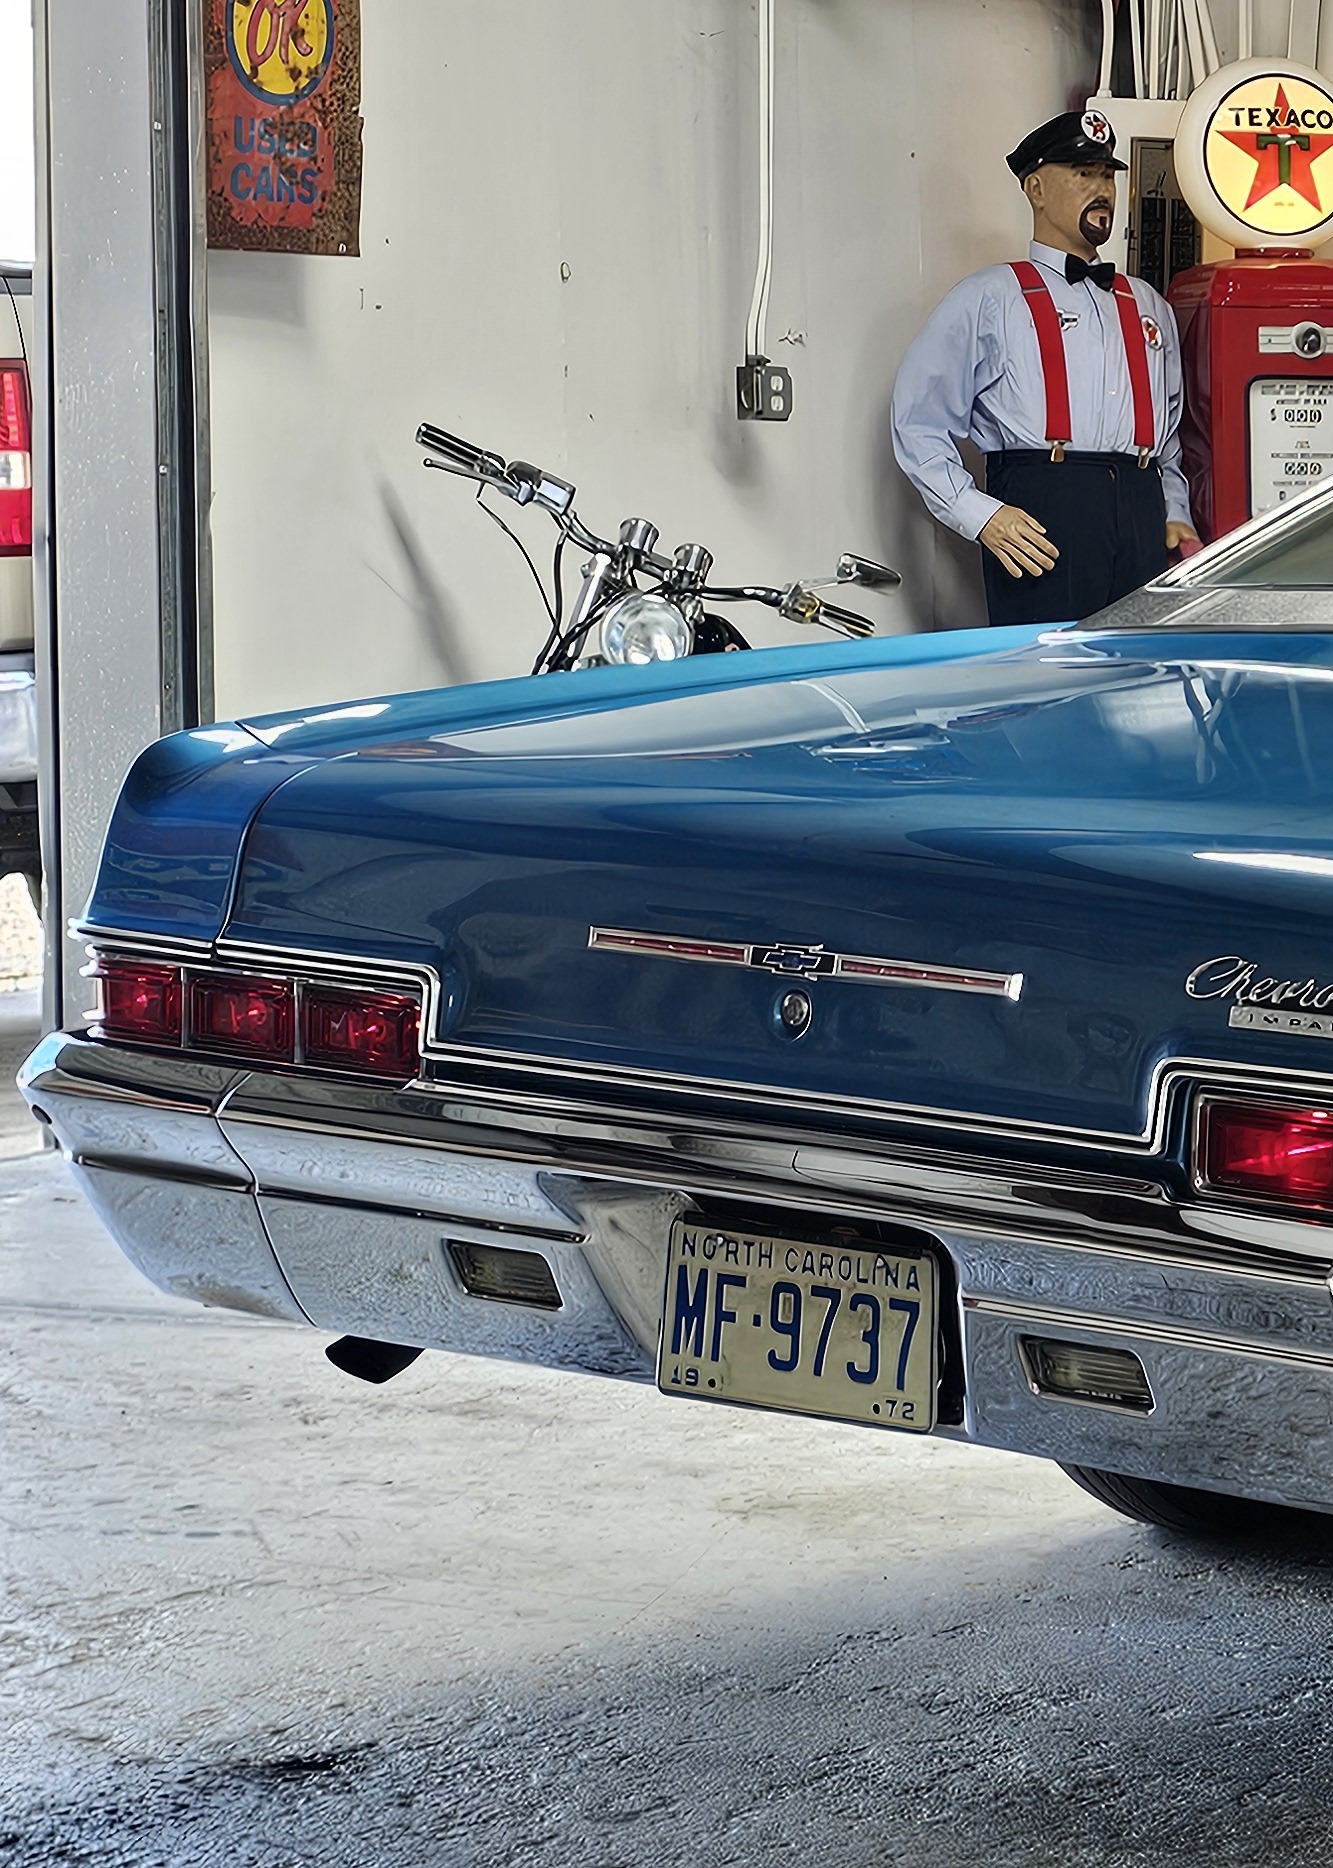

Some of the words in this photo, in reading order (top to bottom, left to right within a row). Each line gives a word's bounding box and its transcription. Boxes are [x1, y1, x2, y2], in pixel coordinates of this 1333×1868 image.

[246, 0, 313, 66] OK
[233, 115, 318, 158] USED
[1228, 107, 1333, 129] TEXACO
[230, 162, 318, 204] CARS
[682, 1232, 773, 1268] NORTH
[785, 1247, 920, 1292] CAROLINA
[671, 1365, 699, 1386] 19
[885, 1400, 915, 1421] 72
